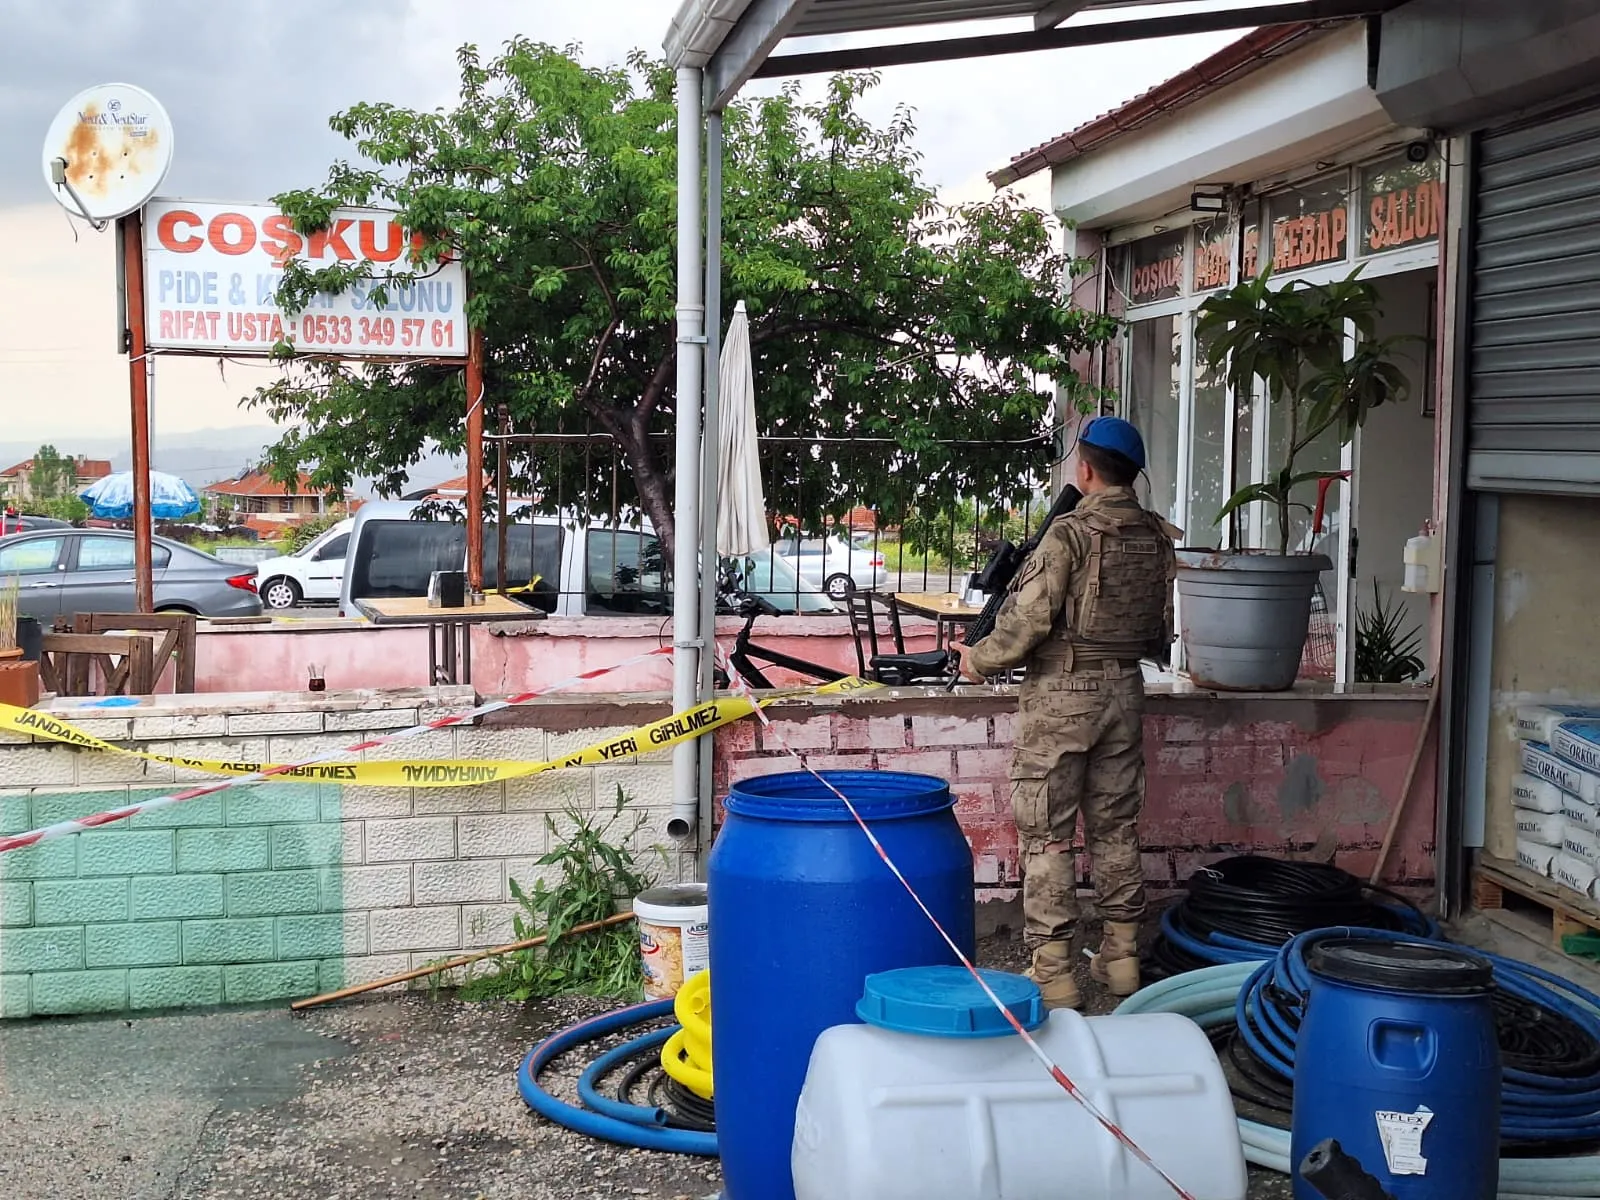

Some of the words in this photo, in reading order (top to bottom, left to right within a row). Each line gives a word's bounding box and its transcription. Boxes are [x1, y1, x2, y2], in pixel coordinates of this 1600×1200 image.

[112, 112, 147, 125] NextStar
[1273, 207, 1346, 270] KEBAP
[228, 272, 246, 306] &
[160, 310, 220, 340] RIFAT
[227, 311, 285, 341] USTA
[303, 314, 352, 345] 0533
[359, 316, 395, 346] 349
[401, 318, 425, 347] 57
[431, 319, 453, 347] 61
